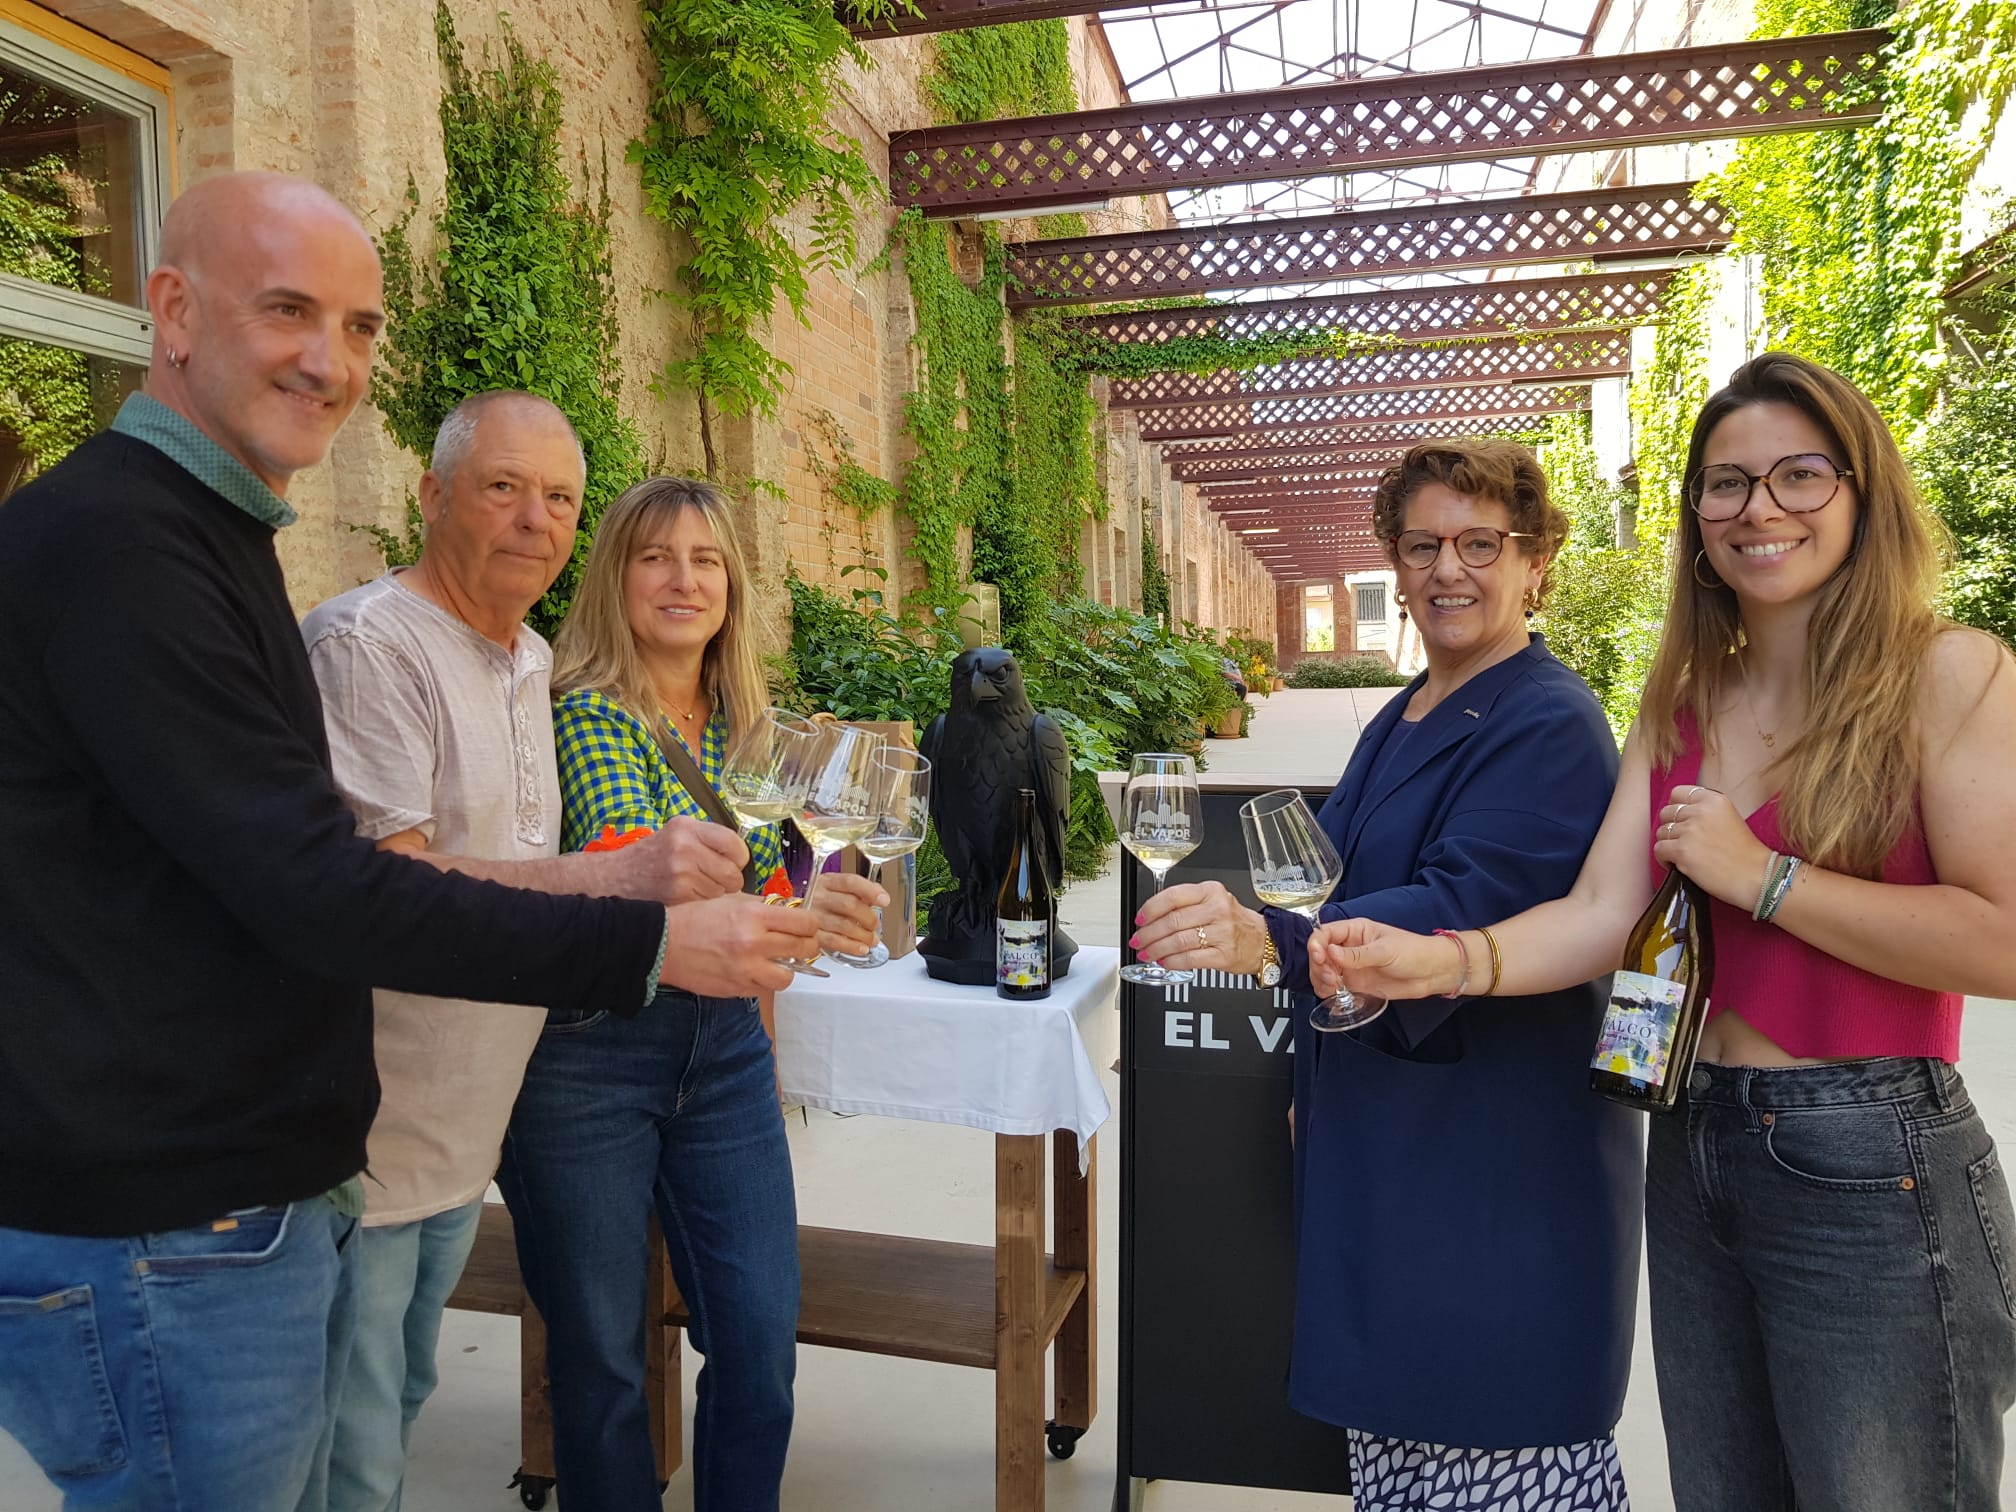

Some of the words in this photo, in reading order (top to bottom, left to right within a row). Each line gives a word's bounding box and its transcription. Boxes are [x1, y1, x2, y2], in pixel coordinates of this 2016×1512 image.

[1135, 827, 1147, 838] EL
[1151, 828, 1190, 839] VAPOR
[1164, 1010, 1230, 1050] EL
[1248, 1015, 1295, 1053] V
[1603, 1016, 1651, 1039] FALCO
